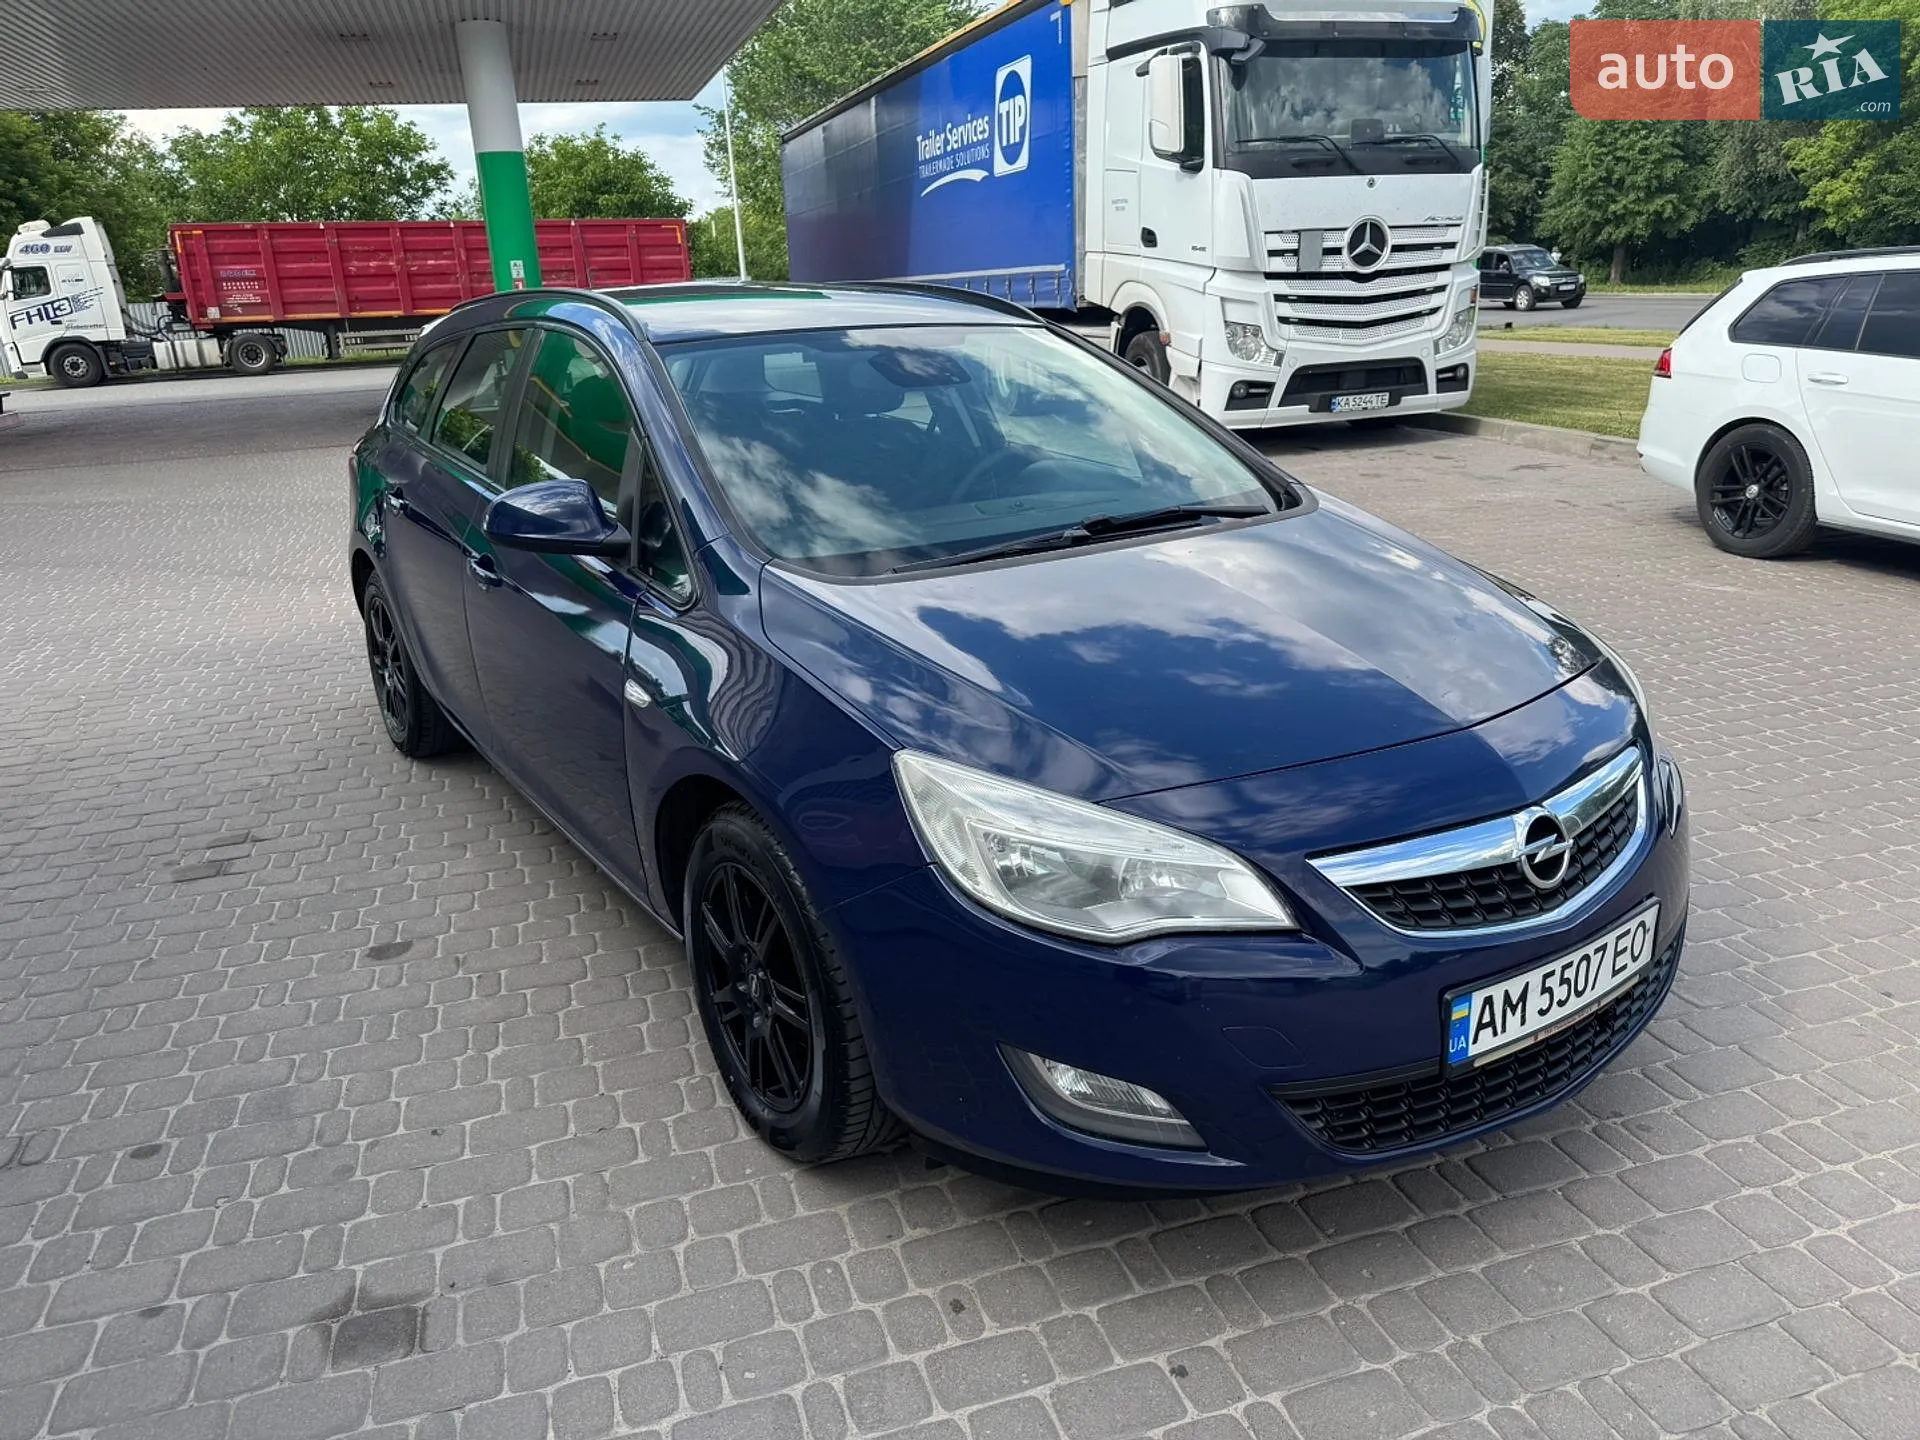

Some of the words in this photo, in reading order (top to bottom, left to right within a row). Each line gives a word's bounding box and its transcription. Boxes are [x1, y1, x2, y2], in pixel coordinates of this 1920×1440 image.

[916, 129, 946, 162] Trailer
[945, 113, 990, 152] Services
[998, 94, 1027, 147] TIP
[955, 142, 991, 168] SOLUTIONS
[1337, 397, 1351, 408] KA
[1471, 980, 1530, 1046] AM
[1537, 942, 1609, 1018] 5507
[1611, 919, 1648, 980] EO
[1448, 1036, 1468, 1053] UA
